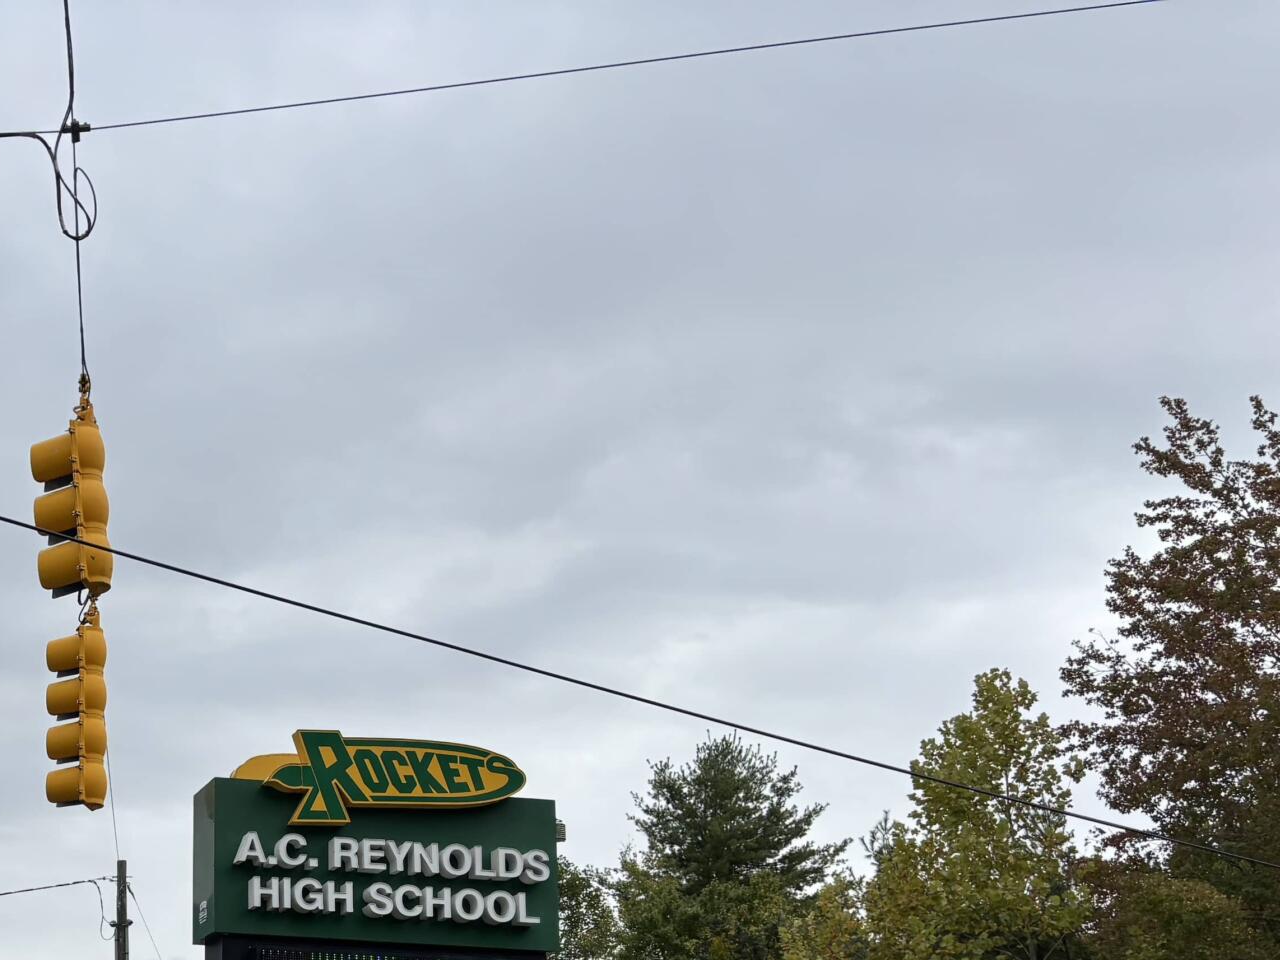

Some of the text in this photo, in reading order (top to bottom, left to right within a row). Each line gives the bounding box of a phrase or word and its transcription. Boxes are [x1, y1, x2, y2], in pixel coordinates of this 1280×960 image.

[288, 730, 526, 826] ROCKETS
[233, 831, 550, 884] A.C. REYNOLDS
[248, 876, 354, 914] HIGH
[363, 882, 541, 927] SCHOOL
